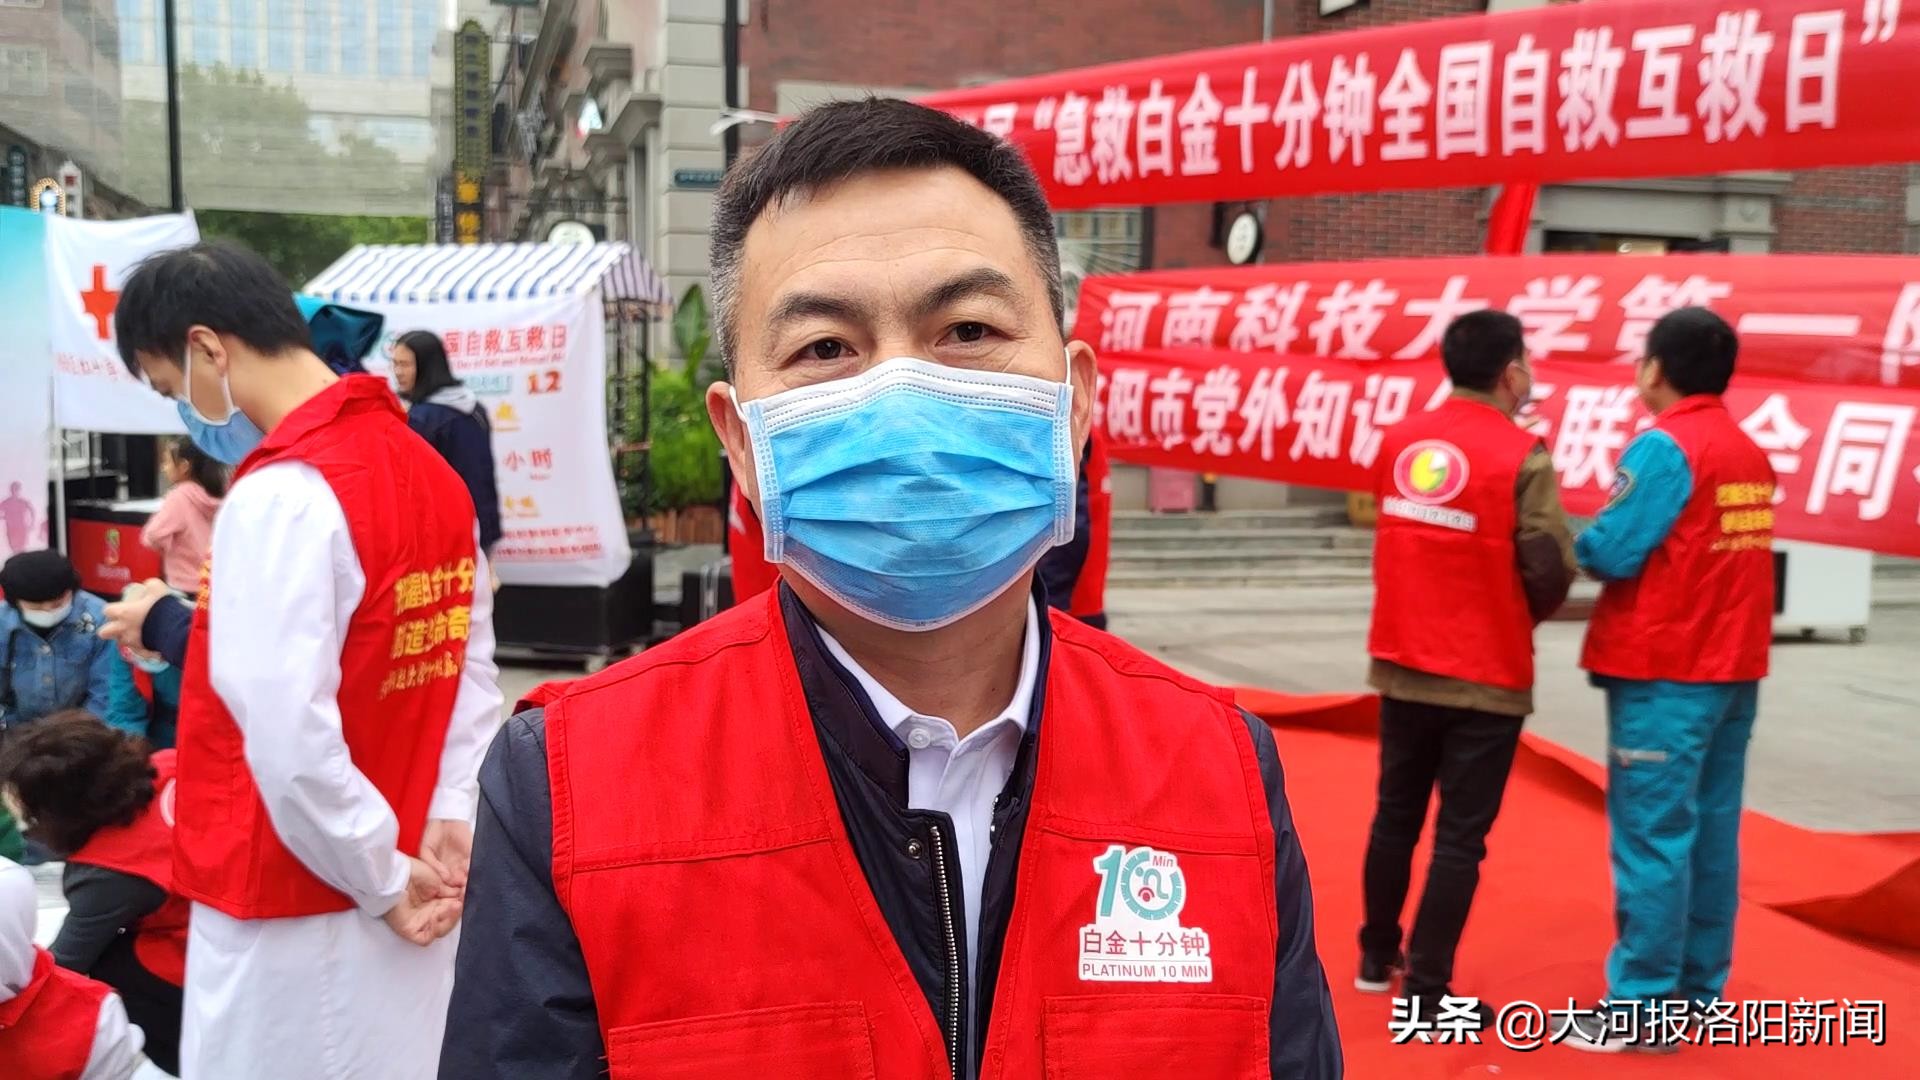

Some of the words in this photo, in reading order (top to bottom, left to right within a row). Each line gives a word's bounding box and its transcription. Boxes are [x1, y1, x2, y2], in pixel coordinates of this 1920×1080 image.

[1151, 855, 1174, 868] Min
[1083, 929, 1206, 957] 白金十分钟
[1082, 963, 1156, 977] PLATINUM
[1161, 965, 1177, 978] 10
[1181, 965, 1208, 977] MIN
